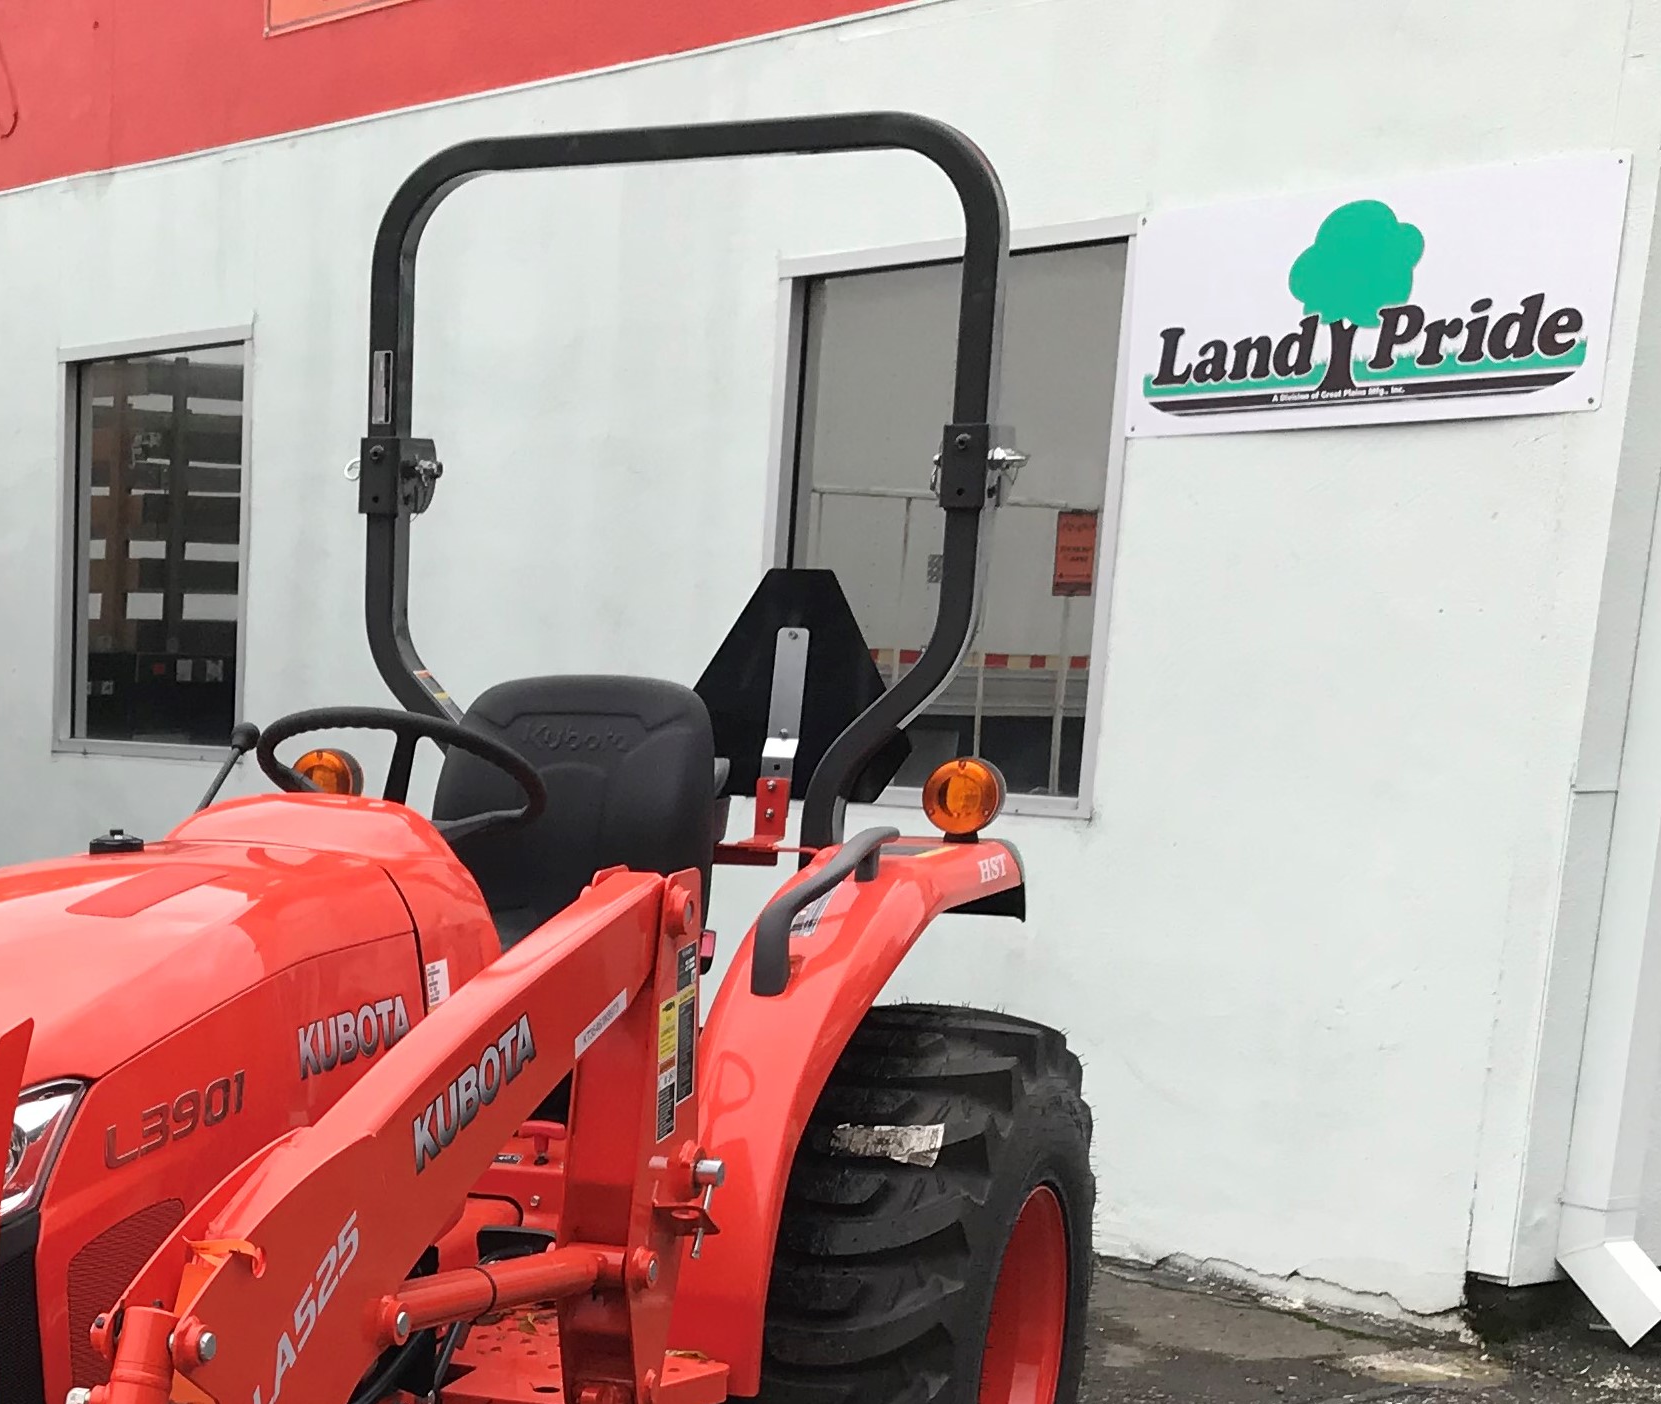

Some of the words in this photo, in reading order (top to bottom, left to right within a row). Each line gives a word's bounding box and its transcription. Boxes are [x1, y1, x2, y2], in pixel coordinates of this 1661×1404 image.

[1151, 314, 1320, 387] Land
[1367, 292, 1584, 371] Pride
[977, 853, 1007, 884] HST
[297, 995, 411, 1081] KUBOTA
[104, 1069, 246, 1170] L3901
[413, 1011, 536, 1176] KUBOTA
